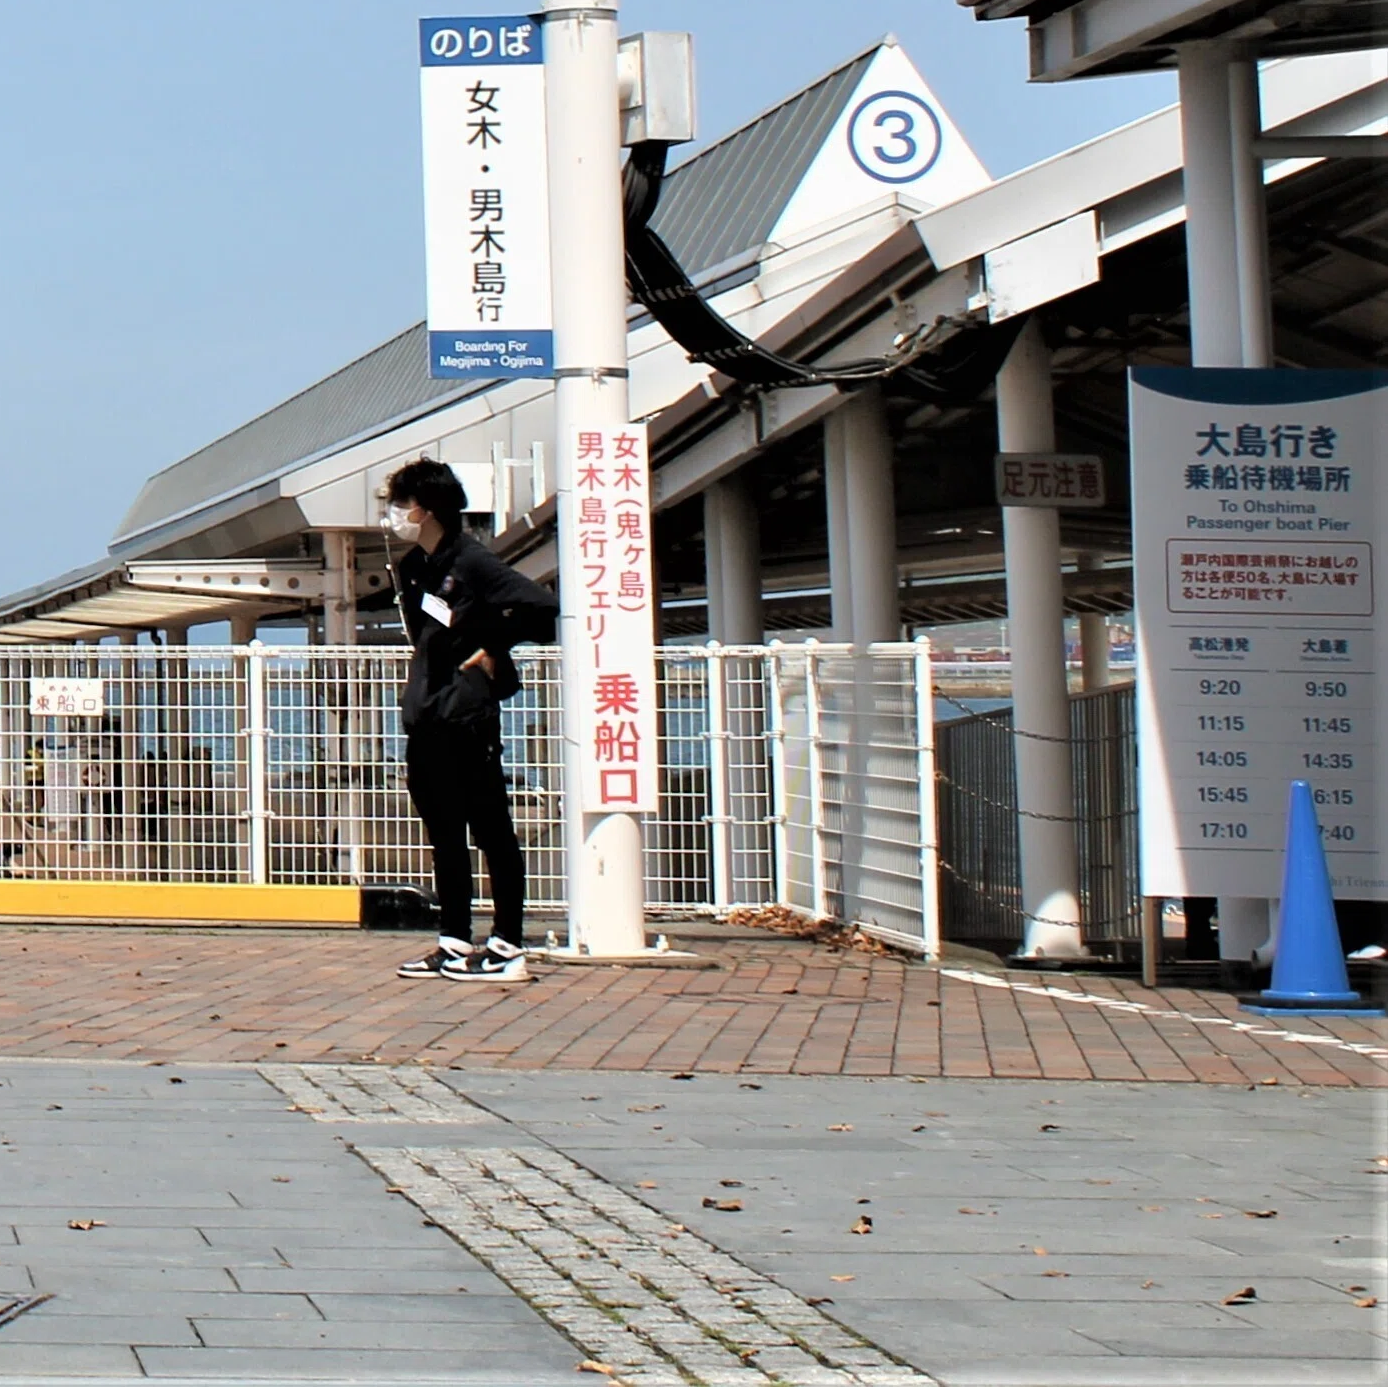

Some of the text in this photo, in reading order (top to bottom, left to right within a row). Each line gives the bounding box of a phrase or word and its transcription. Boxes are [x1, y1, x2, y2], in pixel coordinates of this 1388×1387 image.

[430, 24, 532, 58] のりば
[465, 80, 506, 323] 女木・男木島行
[455, 341, 528, 354] Boarding For
[440, 356, 490, 369] Megijima
[500, 356, 544, 369] Ogijima
[1196, 423, 1337, 458] 大島行き
[1001, 461, 1101, 499] 足元注意
[1184, 464, 1351, 493] 乗船待機場所
[1219, 499, 1317, 514] To Ohshima
[1187, 515, 1351, 532] Passenger boat Pier
[577, 432, 612, 668] 男木島行フェリー
[1188, 637, 1249, 652] 高松港発
[1302, 639, 1348, 654] 大島着
[1200, 679, 1241, 695] 9:20
[1305, 681, 1347, 698] 9:50
[35, 694, 96, 712] 乗船口
[1198, 715, 1244, 732] 11:15
[1303, 717, 1351, 733] 11:45
[593, 673, 641, 804] 乗船口
[1196, 751, 1247, 767] 14:05
[1303, 753, 1353, 769] 14:35
[1198, 787, 1248, 802] 15:45
[1314, 789, 1353, 805] 6:15
[1200, 823, 1247, 838] 17:10
